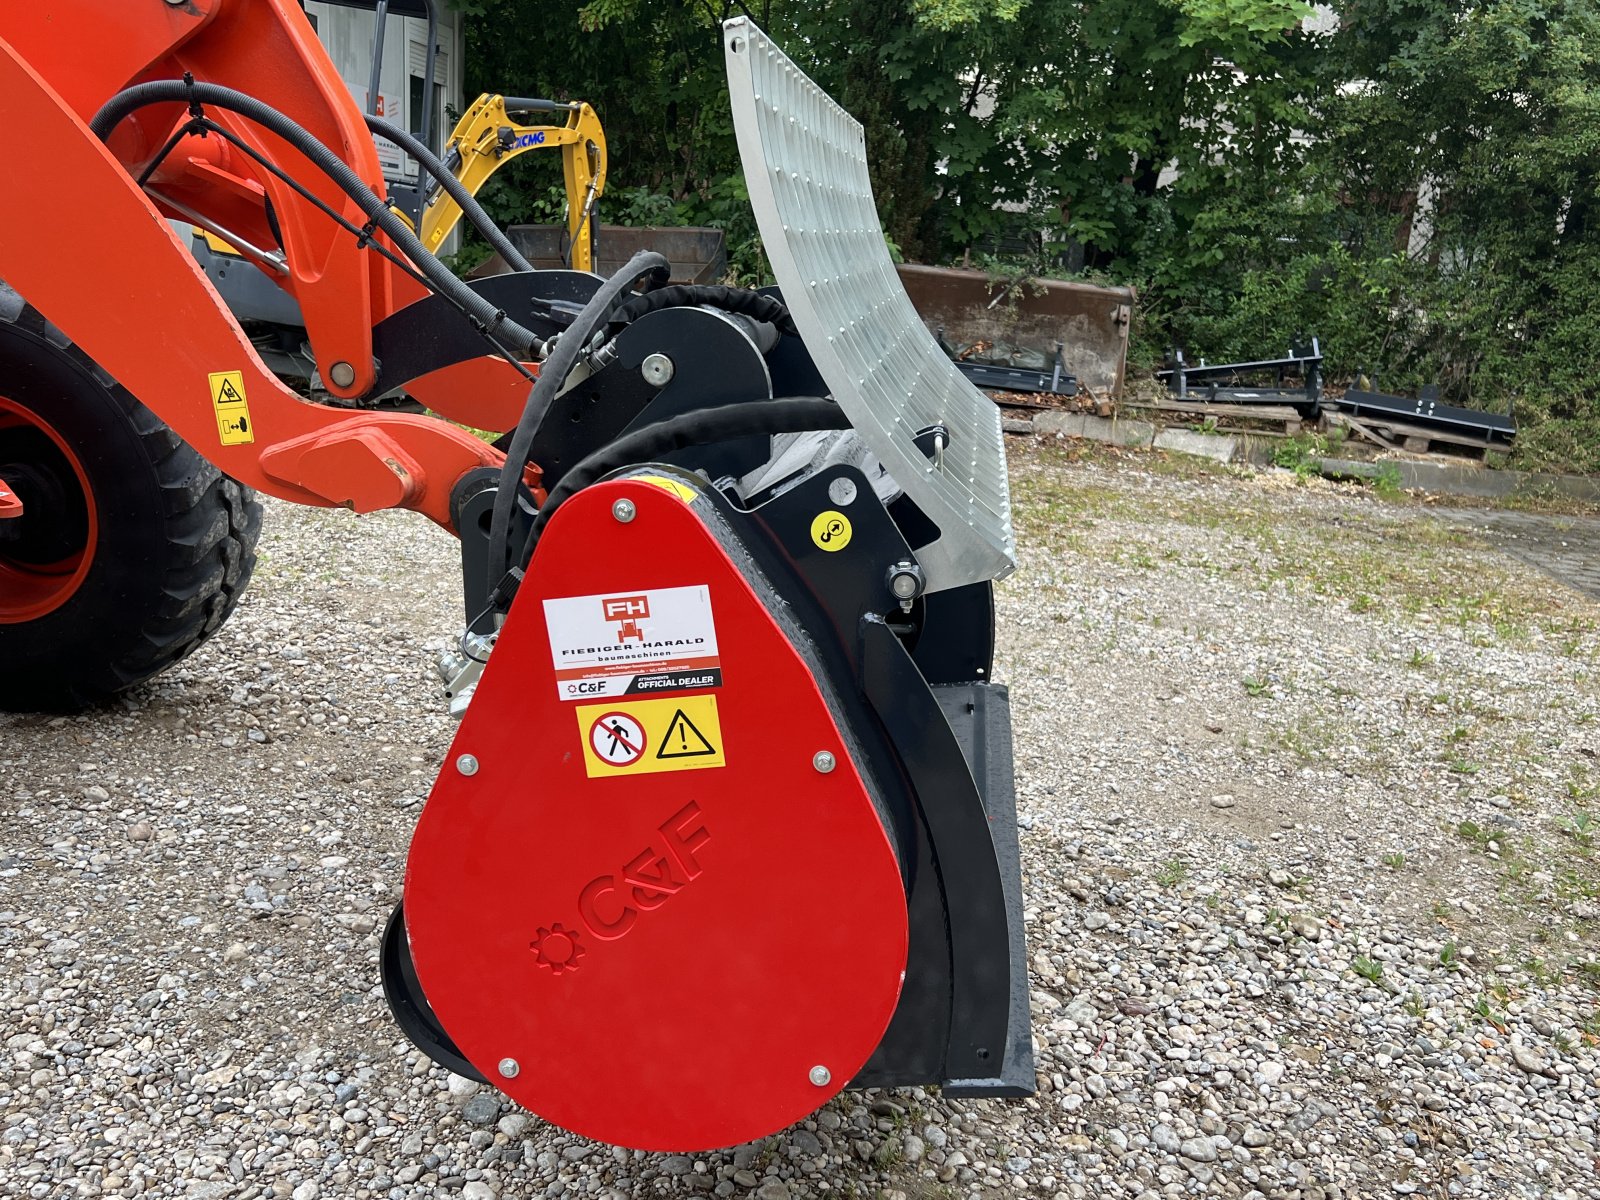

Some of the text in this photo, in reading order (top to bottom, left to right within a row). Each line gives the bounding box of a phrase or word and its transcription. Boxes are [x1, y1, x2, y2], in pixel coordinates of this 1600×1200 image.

[606, 600, 646, 617] FH
[598, 650, 671, 662] baumaschinen
[578, 681, 607, 694] C&F
[637, 679, 677, 689] OFFICIAL
[678, 675, 714, 686] DEALER
[577, 799, 712, 942] C&F
